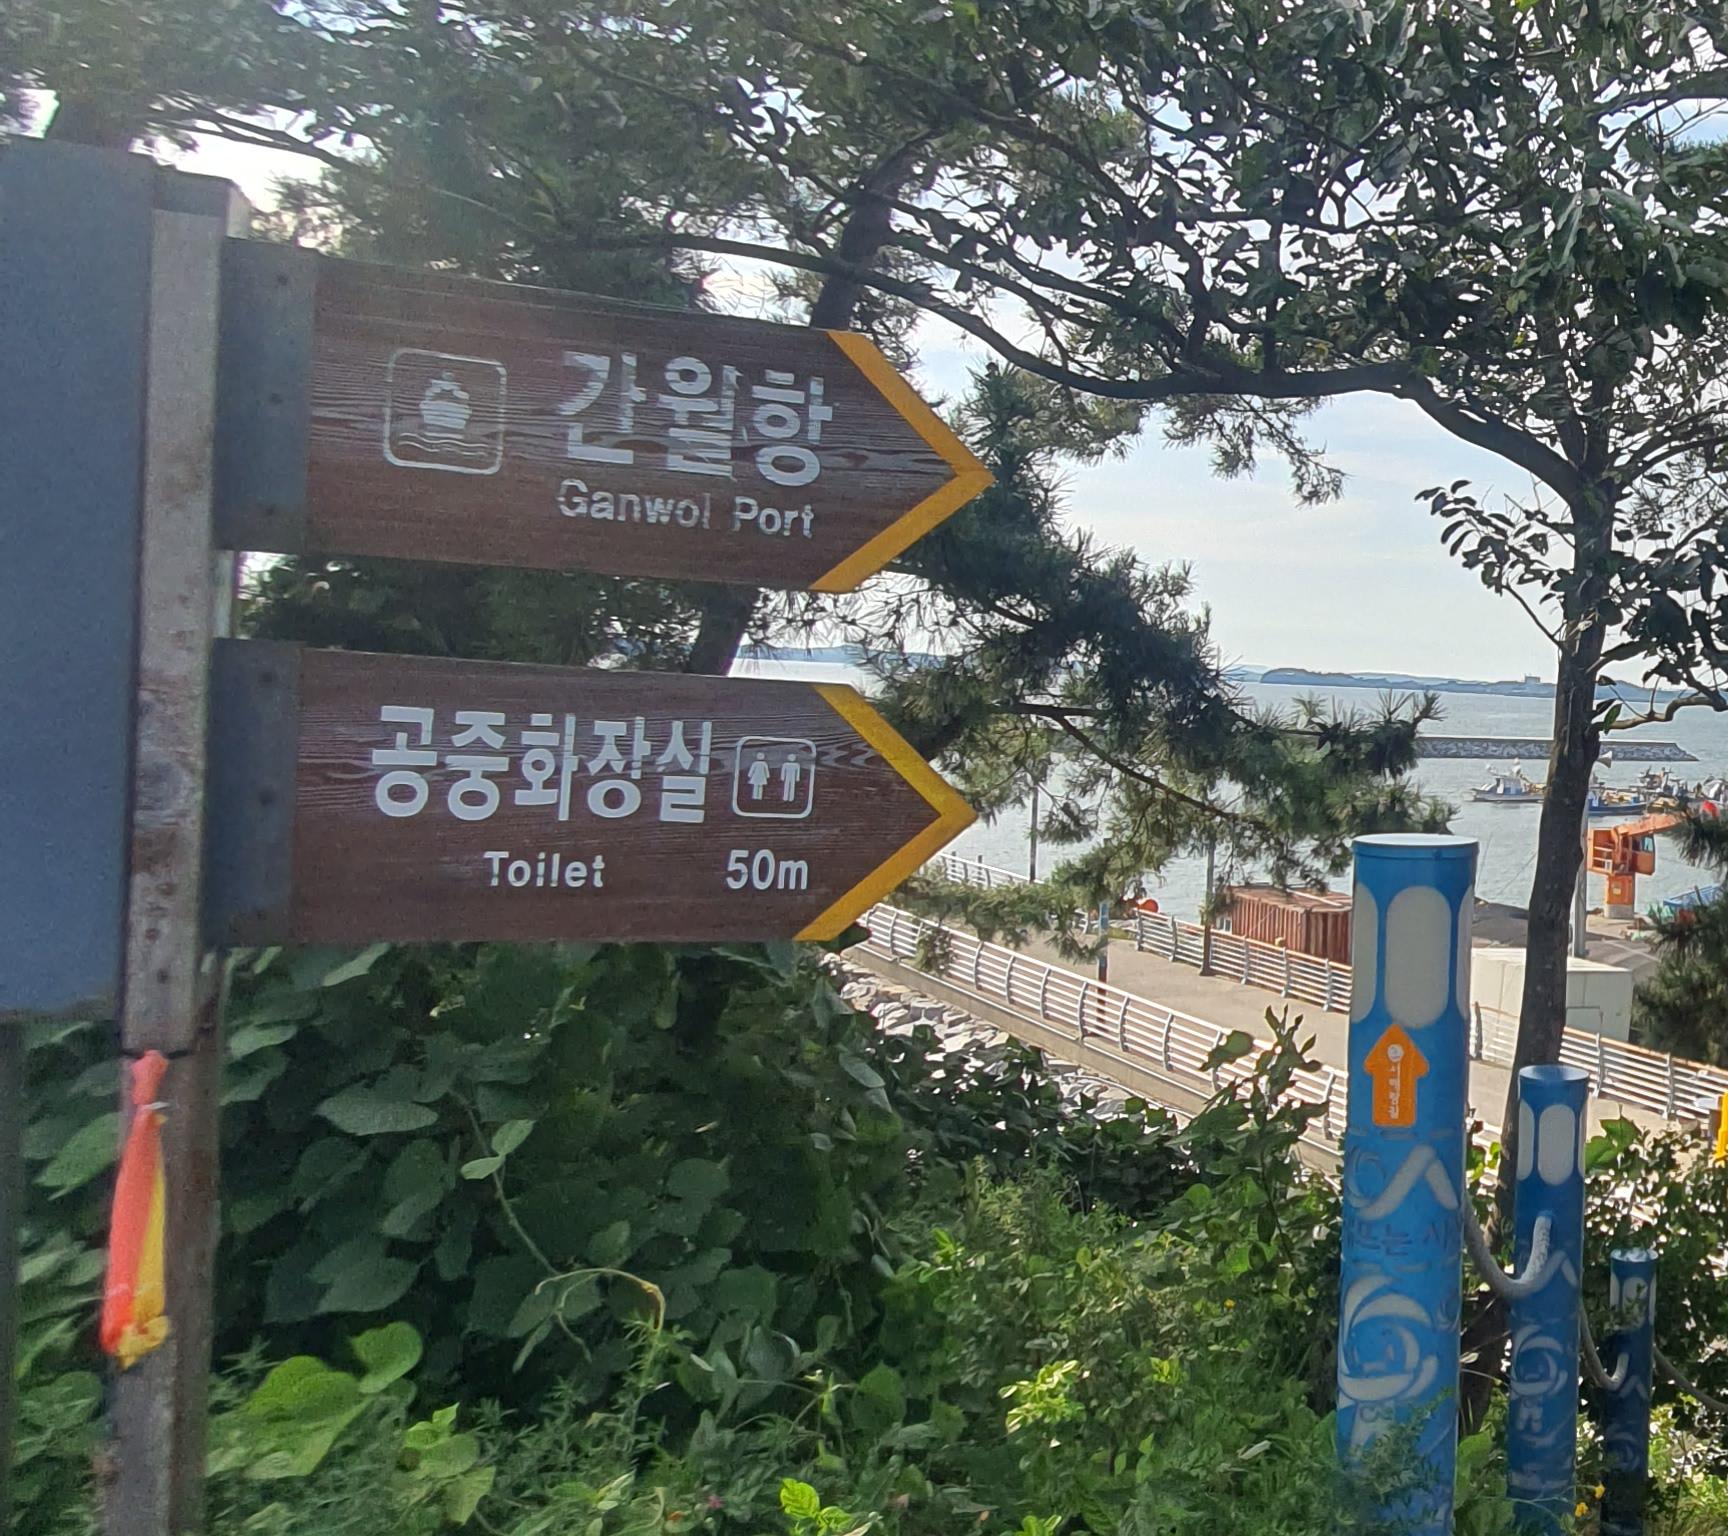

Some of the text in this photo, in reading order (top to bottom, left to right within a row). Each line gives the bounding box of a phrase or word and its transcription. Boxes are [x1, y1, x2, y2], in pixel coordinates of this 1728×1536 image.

[557, 350, 833, 486] 간월항
[556, 477, 815, 539] Ganwol Port
[371, 705, 713, 824] 공중화장실
[483, 848, 809, 891] Toilet 50m
